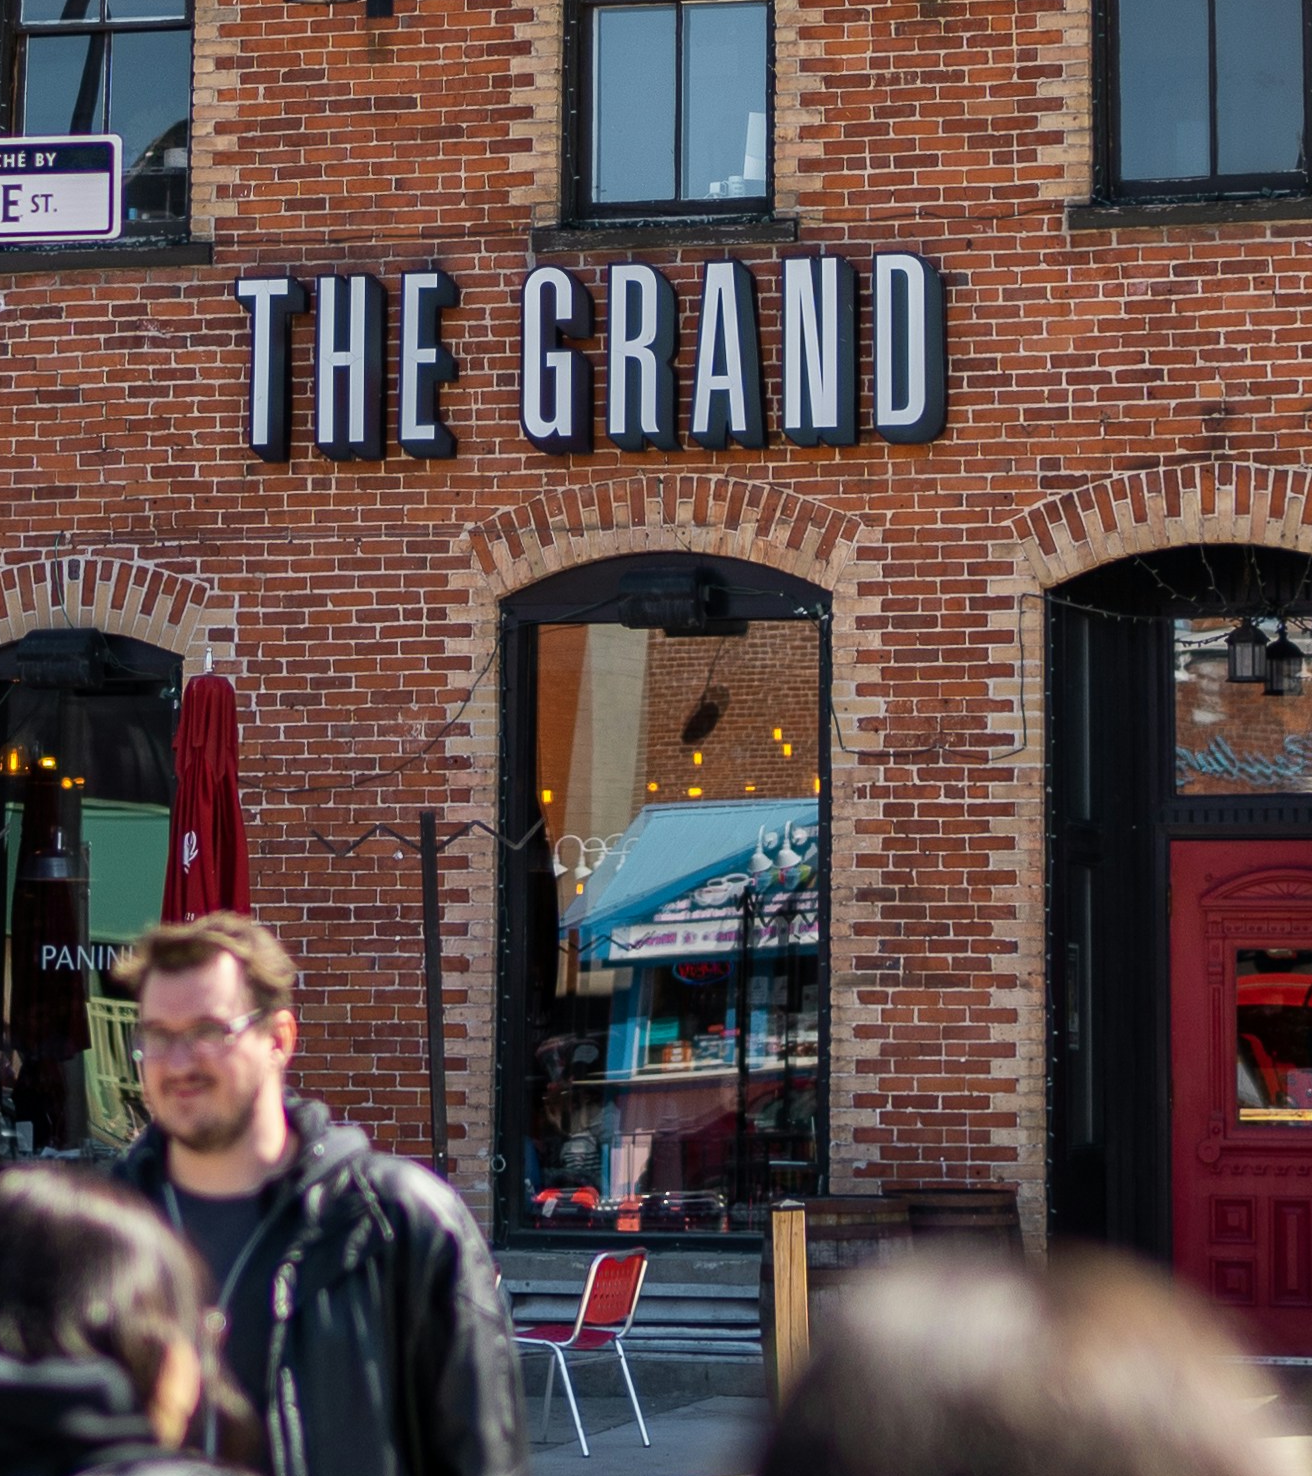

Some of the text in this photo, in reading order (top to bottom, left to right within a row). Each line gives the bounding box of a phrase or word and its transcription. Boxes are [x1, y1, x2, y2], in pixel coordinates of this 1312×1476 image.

[35, 152, 57, 168] BY
[31, 194, 58, 214] ST.
[236, 252, 946, 460] THE GRAND
